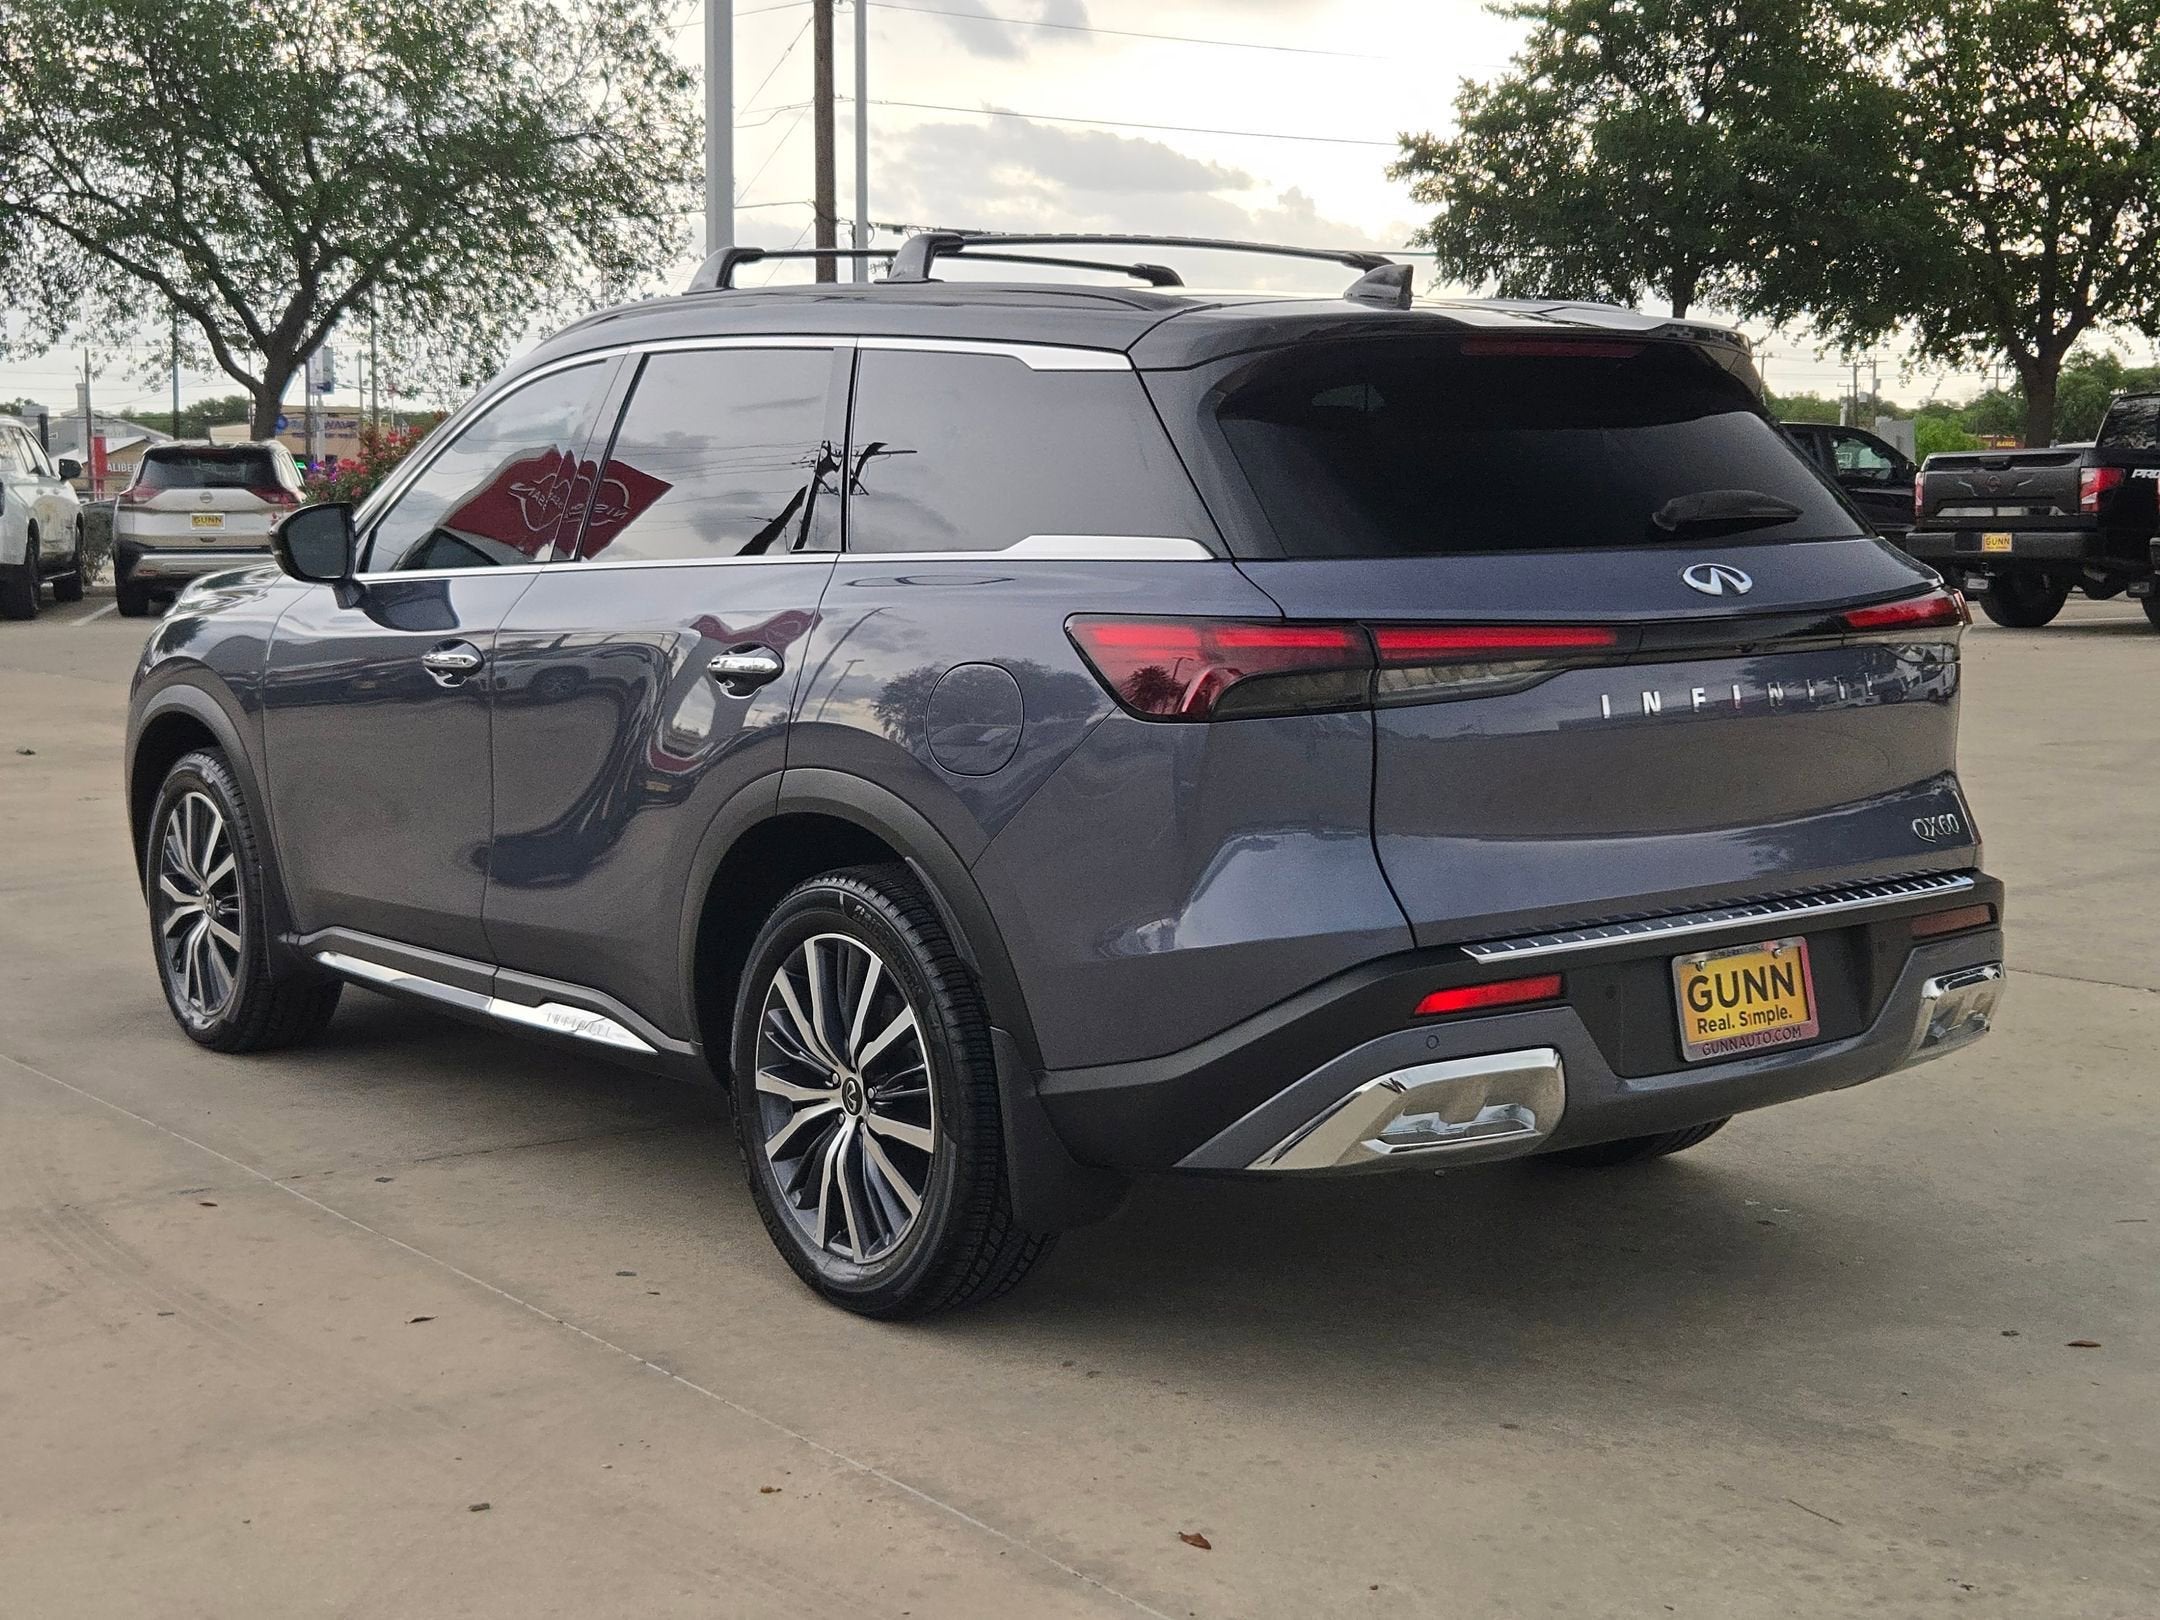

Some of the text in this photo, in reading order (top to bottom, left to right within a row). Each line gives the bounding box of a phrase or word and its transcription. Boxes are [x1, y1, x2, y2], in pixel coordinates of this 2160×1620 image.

[107, 463, 138, 473] ALIBER
[194, 515, 222, 524] GUNN
[1986, 537, 2010, 546] GUNN
[1601, 672, 1873, 718] INFINITI
[1912, 813, 1960, 843] QX60
[1687, 962, 1796, 1012] GUNN
[1697, 1012, 1736, 1034] Real.
[1702, 1025, 1802, 1056] GUNNAUTO.COM
